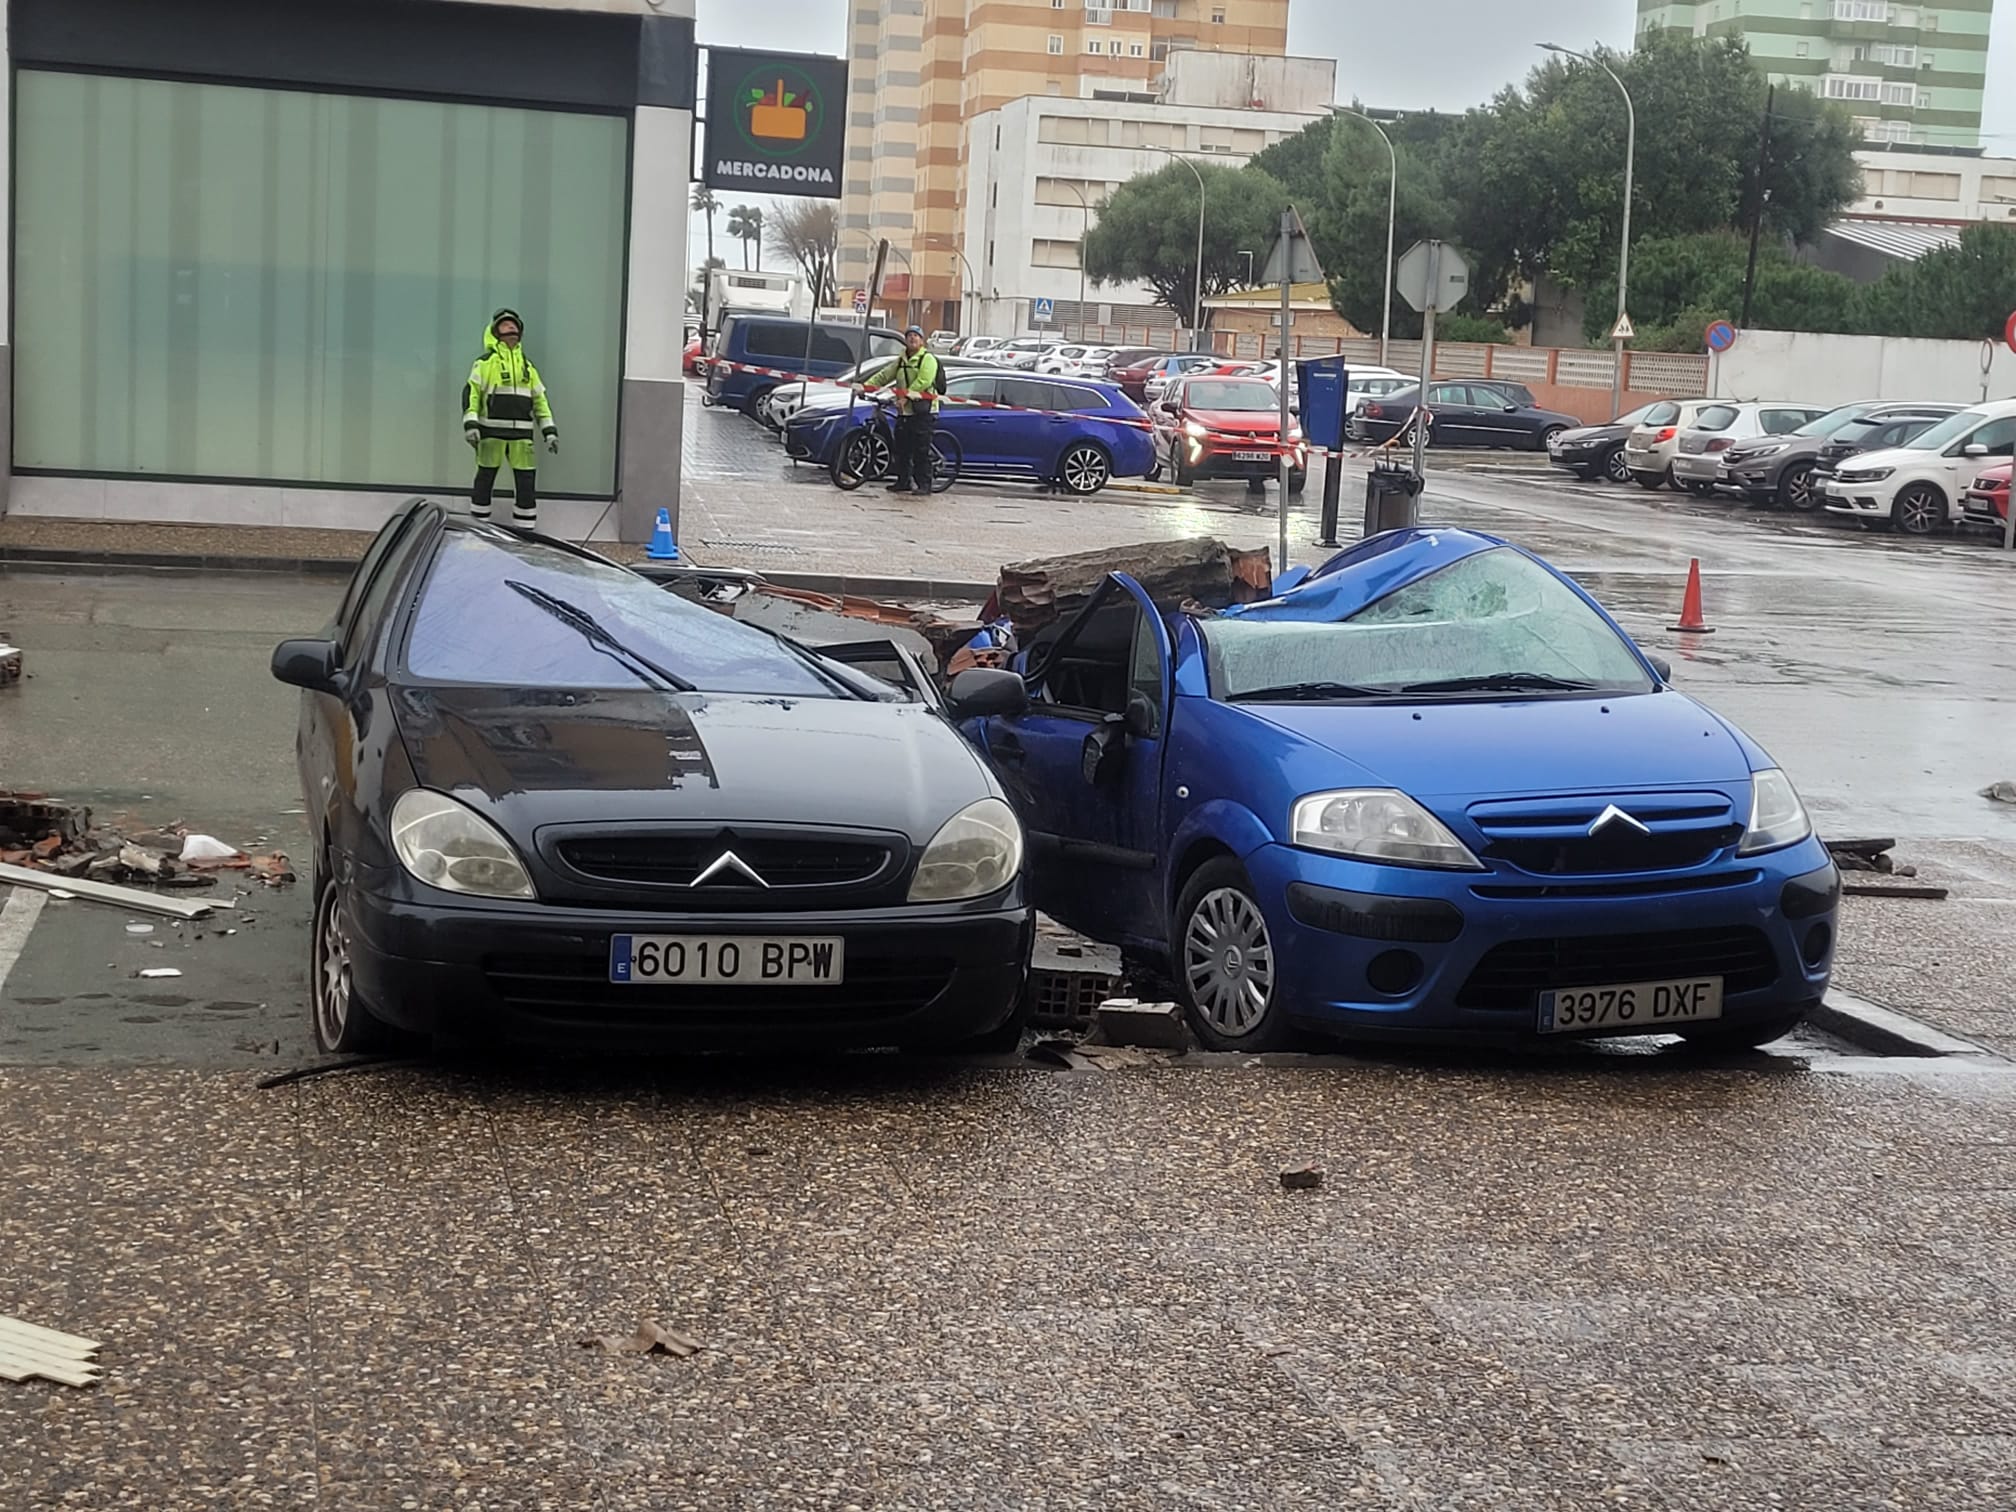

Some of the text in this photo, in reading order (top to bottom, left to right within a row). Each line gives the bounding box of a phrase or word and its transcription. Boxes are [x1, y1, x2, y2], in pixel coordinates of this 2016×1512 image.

[717, 160, 833, 183] MERCADONA
[617, 941, 833, 978] E 6010 BPW
[1559, 989, 1635, 1025] 3976
[1653, 983, 1711, 1017] DXF
